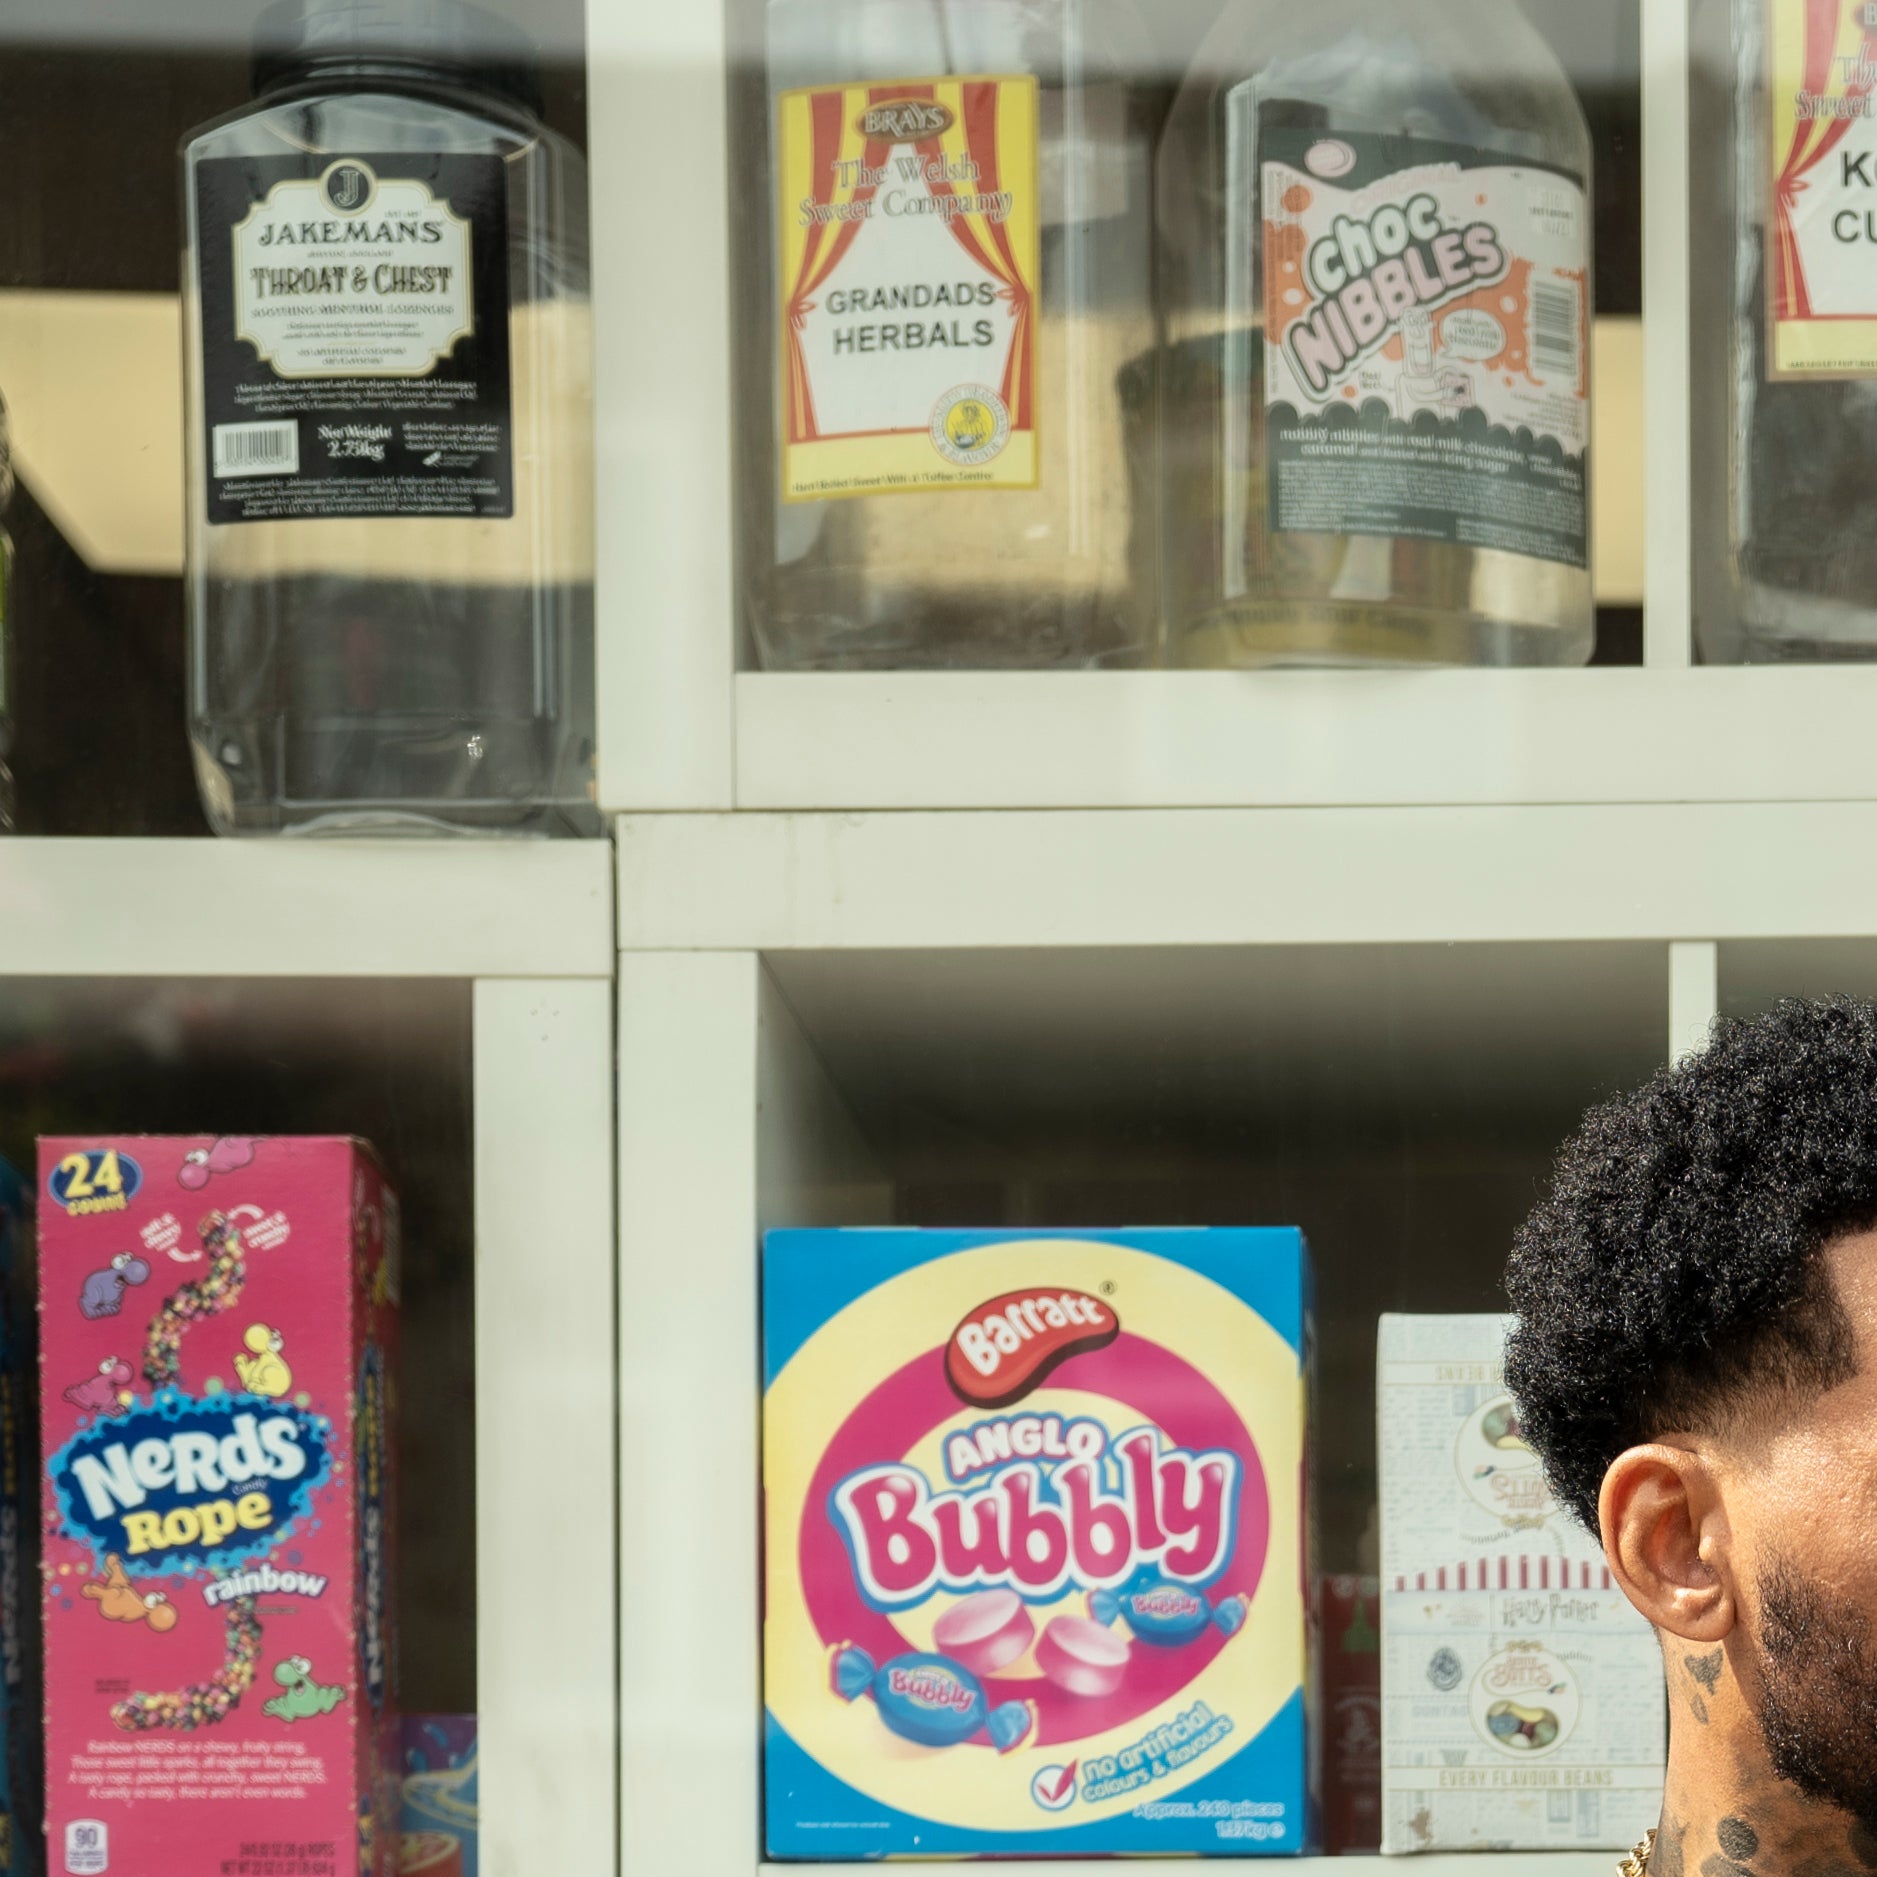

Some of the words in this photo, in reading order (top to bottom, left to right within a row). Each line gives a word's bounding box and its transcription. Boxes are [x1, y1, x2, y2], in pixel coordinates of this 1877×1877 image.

[865, 104, 944, 134] BRAYS
[1794, 89, 1873, 120] Sweet
[834, 160, 887, 190] The
[895, 154, 979, 183] Welsh
[799, 198, 875, 226] Sweet
[883, 190, 1013, 225] Company
[258, 220, 444, 246] JAKEMANS
[1310, 193, 1439, 290] choc
[252, 265, 347, 298] THROAT
[351, 268, 368, 293] &
[373, 263, 452, 295] CHEST
[825, 282, 995, 315] GRANDADS
[1290, 223, 1503, 391] NIBBLES
[834, 321, 994, 354] HERBALS
[60, 1151, 123, 1198] 24
[67, 1195, 127, 1216] COUNT
[957, 1293, 1107, 1377] Barratt
[948, 1417, 1103, 1477] ANGLO
[846, 1427, 1231, 1596] Bubbly
[203, 1567, 328, 1608] rainbow
[1132, 1593, 1199, 1616] Bubbly
[890, 1667, 975, 1713] Bubbly
[1083, 1757, 1116, 1779] no
[1117, 1700, 1214, 1768] artificial
[1081, 1769, 1149, 1803] colours
[1151, 1761, 1165, 1779] &
[1167, 1714, 1233, 1773] flavours
[1439, 1769, 1487, 1786] EVERY
[1492, 1769, 1558, 1786] FLAVOUR
[1564, 1769, 1614, 1786] BEANS
[1134, 1802, 1197, 1820] Approx.
[1232, 1801, 1285, 1820] pieces
[75, 1826, 98, 1848] 90
